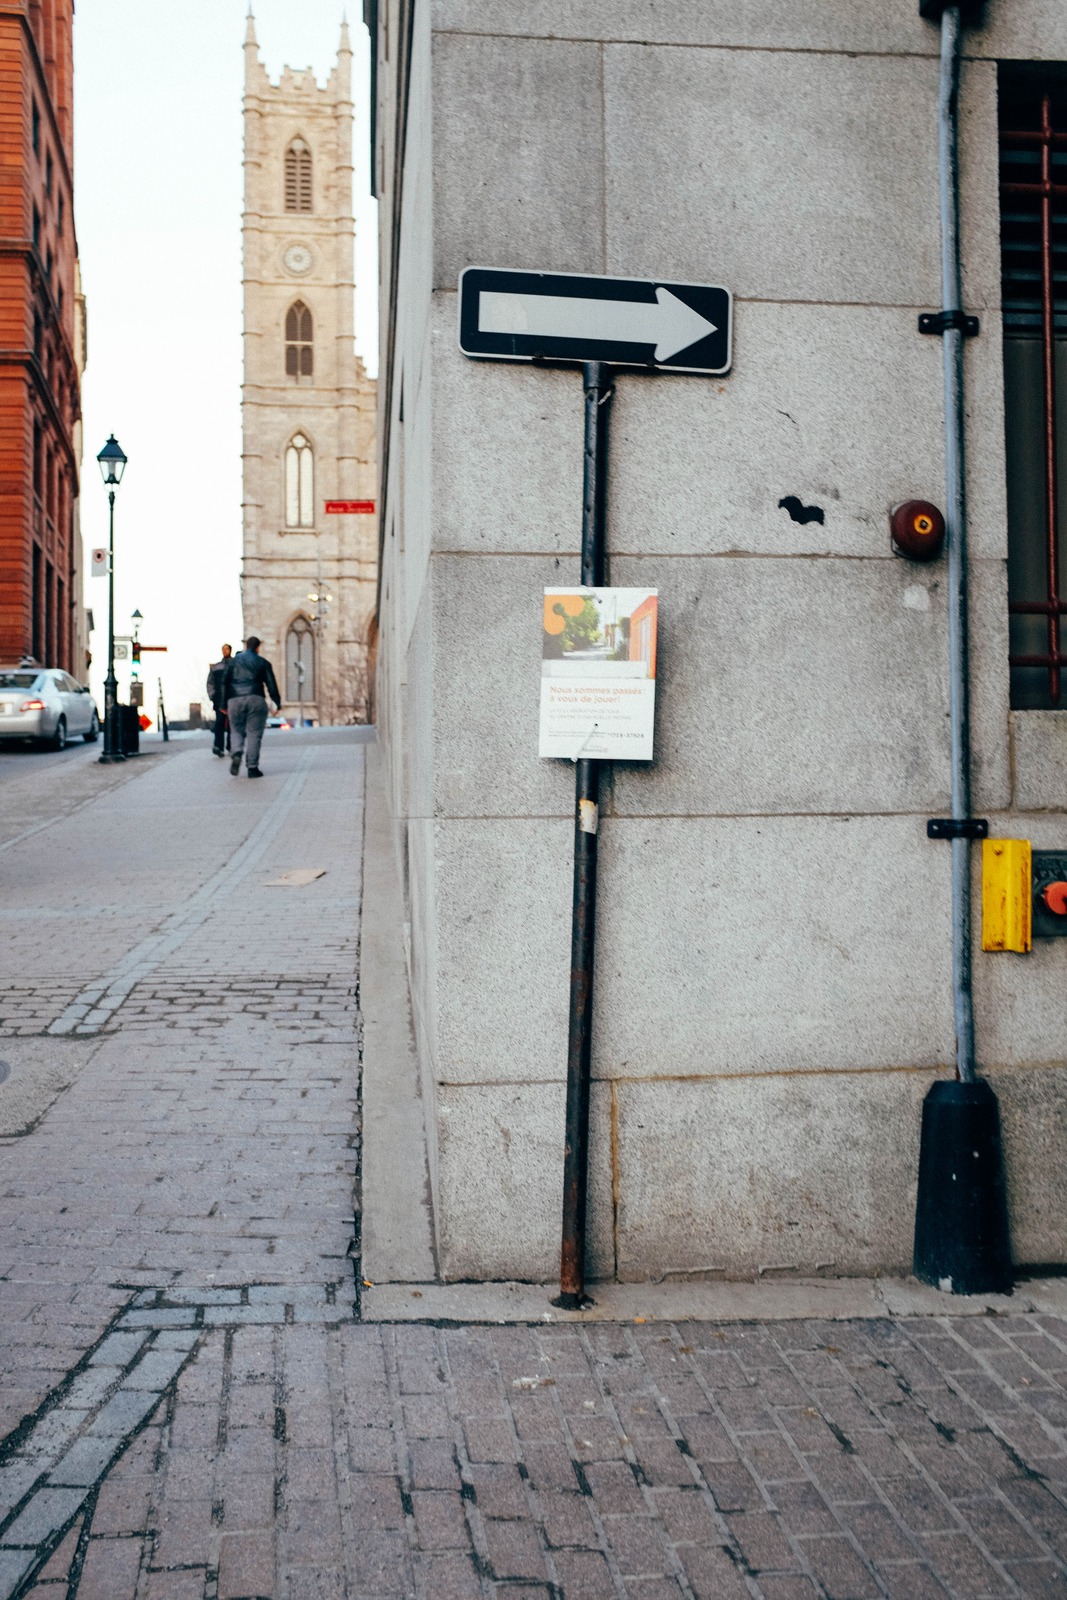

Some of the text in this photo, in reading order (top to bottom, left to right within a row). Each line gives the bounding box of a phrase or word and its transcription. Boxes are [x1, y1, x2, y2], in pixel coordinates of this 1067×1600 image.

[550, 686, 572, 694] Nous
[574, 687, 610, 695] sommes
[580, 695, 592, 703] de
